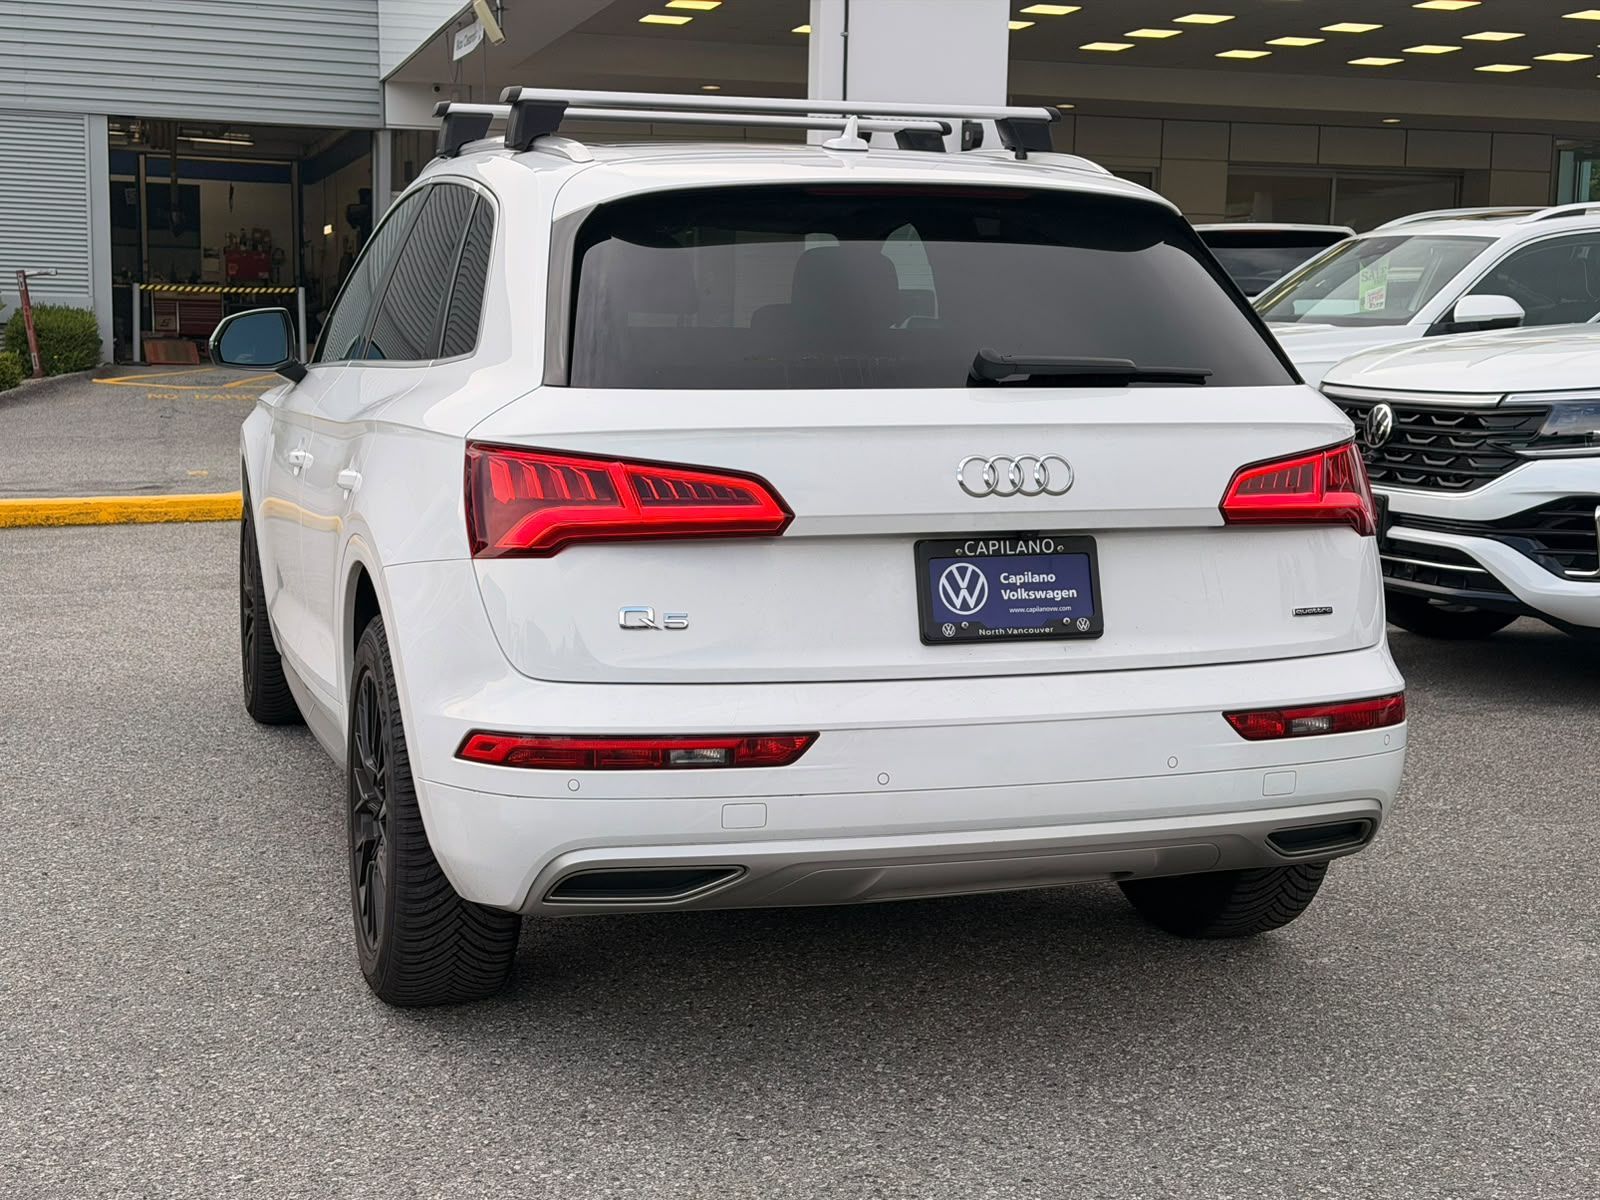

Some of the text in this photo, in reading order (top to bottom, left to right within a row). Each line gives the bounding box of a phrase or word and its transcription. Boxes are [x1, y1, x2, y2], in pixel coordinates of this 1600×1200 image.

[964, 538, 1055, 556] CAPILANO
[1000, 571, 1056, 586] Capilano
[938, 562, 989, 616] VW
[1001, 588, 1078, 601] Volkswagen
[1008, 605, 1072, 614] www.capilanovw.com
[1294, 606, 1332, 615] quattro
[619, 606, 689, 630] Q5
[979, 627, 1054, 636] North Vancouver
